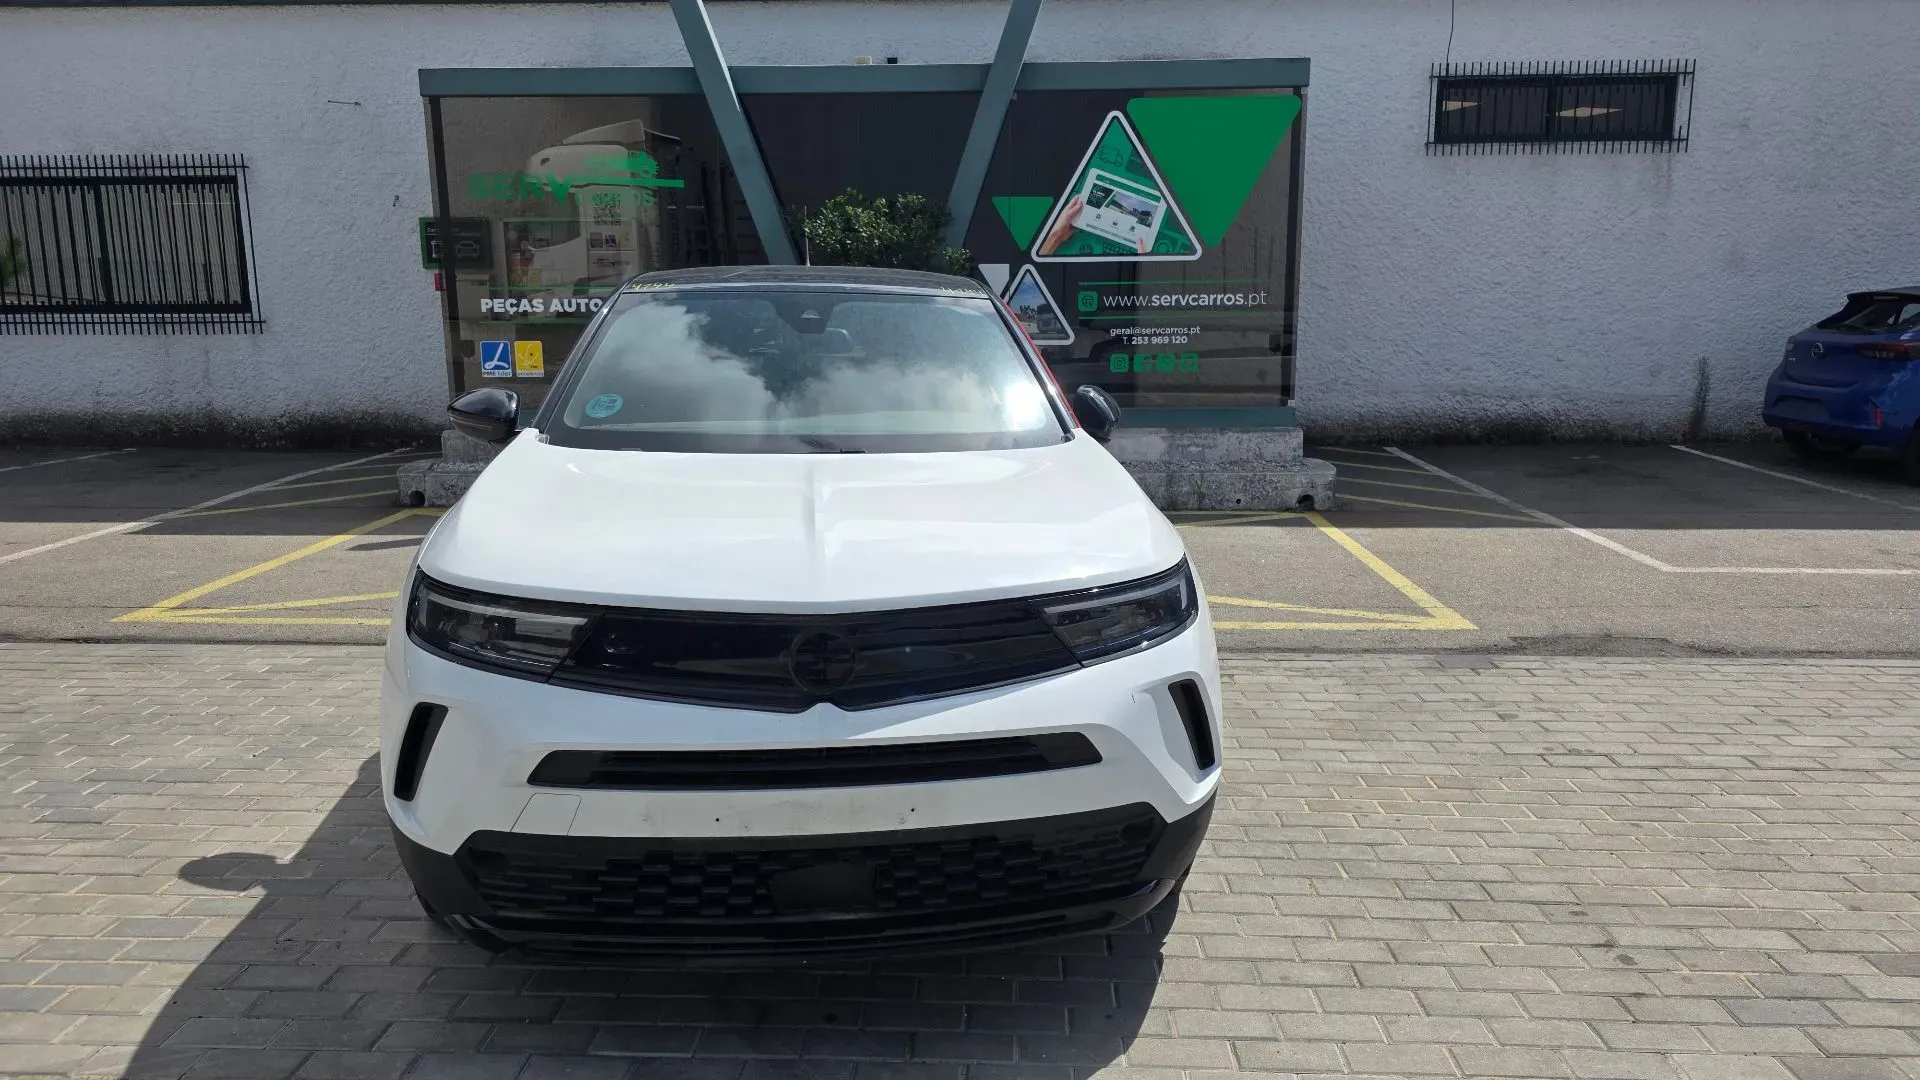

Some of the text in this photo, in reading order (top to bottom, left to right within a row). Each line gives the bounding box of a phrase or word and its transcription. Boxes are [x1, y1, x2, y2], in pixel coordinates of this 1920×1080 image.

[1103, 291, 1267, 307] www.servcarros.pt
[481, 299, 544, 314] PEÇAS
[1110, 326, 1201, 336] geral@servcarros.pt
[1131, 336, 1149, 344] 253
[1151, 336, 1169, 344] 969
[1171, 335, 1188, 344] 120
